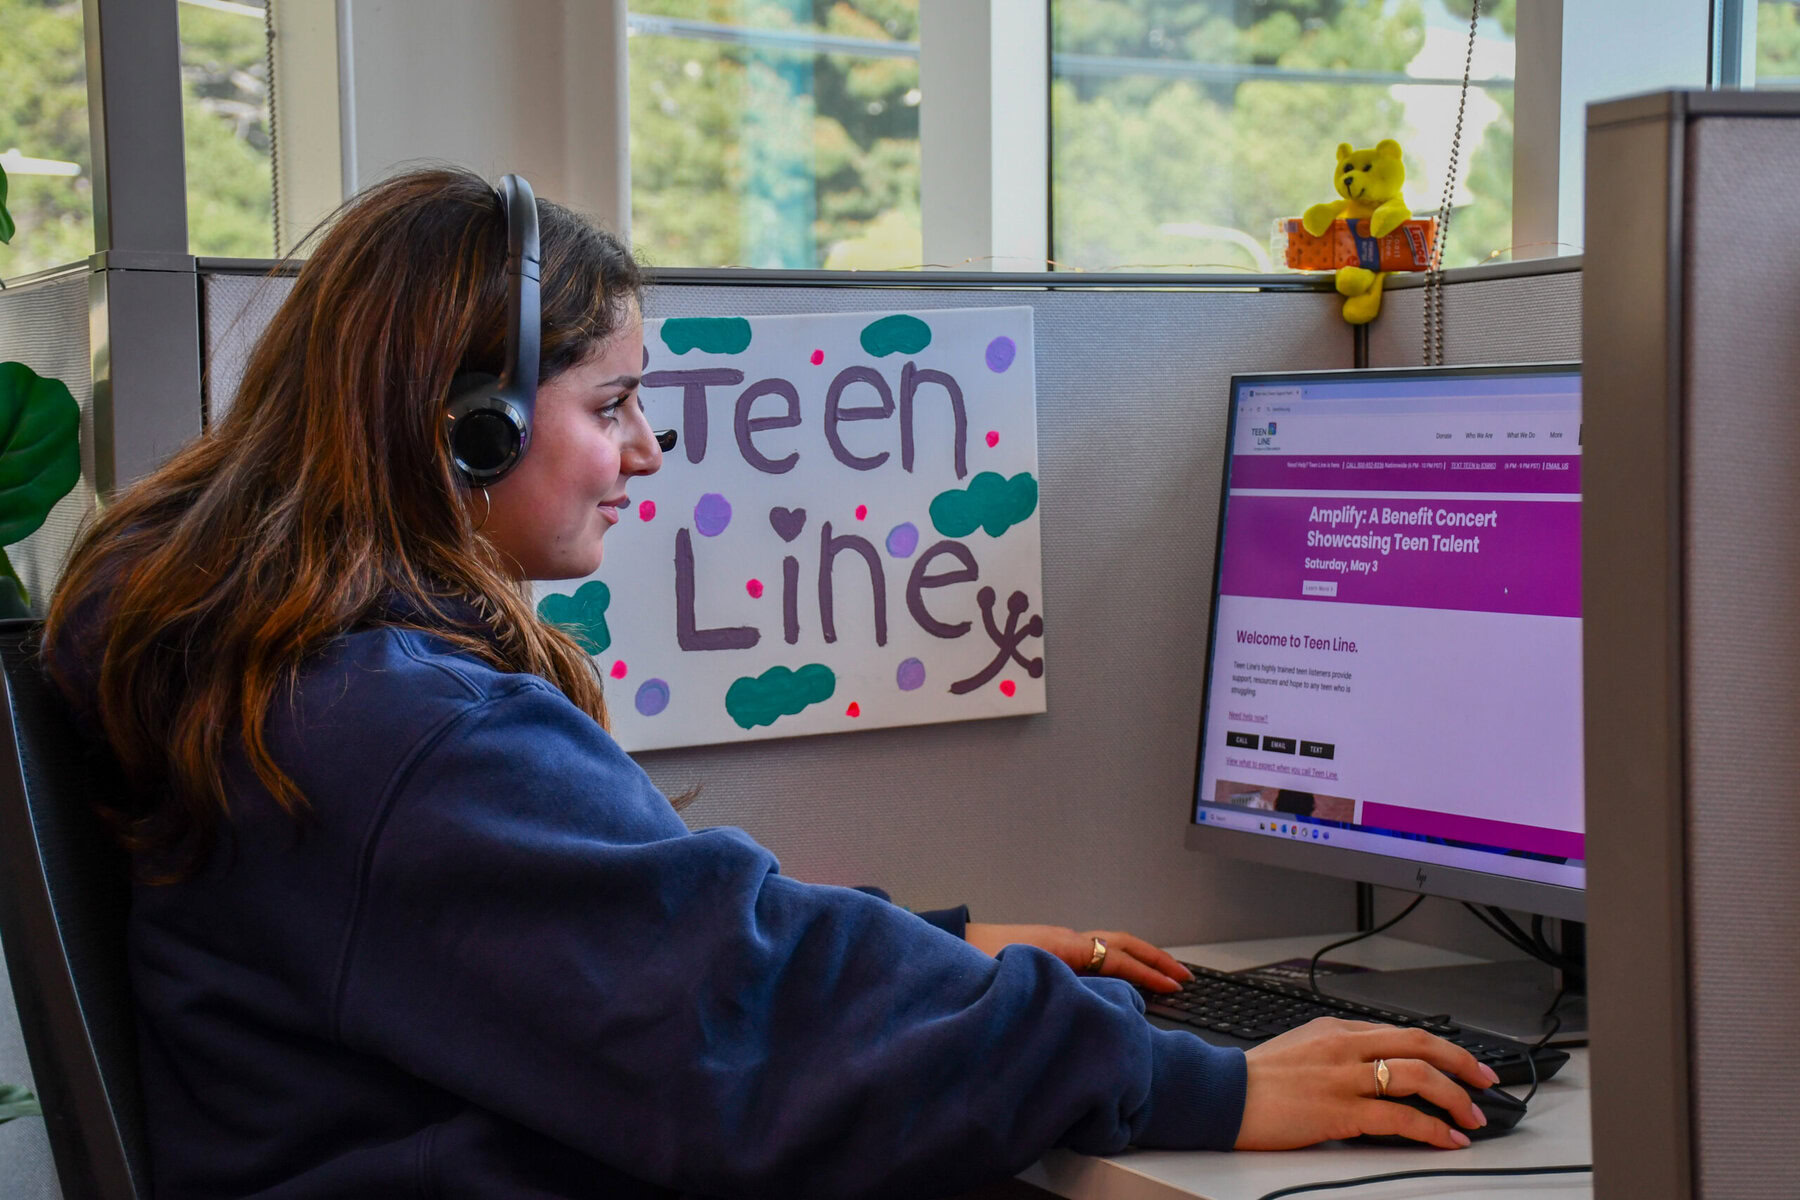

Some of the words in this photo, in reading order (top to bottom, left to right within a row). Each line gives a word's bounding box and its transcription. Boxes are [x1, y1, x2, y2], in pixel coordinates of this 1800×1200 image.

[1410, 225, 1427, 264] Lance
[641, 361, 967, 479] Teen
[1252, 428, 1267, 436] TEEN
[1436, 432, 1452, 440] Donate
[1507, 431, 1519, 439] What
[1520, 431, 1528, 439] We
[1550, 431, 1563, 439] More
[1257, 438, 1271, 446] LINE
[1346, 461, 1357, 469] CALL
[1546, 462, 1560, 470] EMAIL
[1561, 462, 1569, 470] US
[1309, 505, 1367, 529] Amplify:
[1368, 507, 1379, 524] A
[1381, 507, 1433, 526] Benefit
[1435, 509, 1498, 528] Concert
[1307, 530, 1391, 555] Showcasing
[1394, 533, 1429, 551] Teen
[1432, 535, 1480, 553] Talent
[1304, 557, 1349, 574] Saturday,
[1350, 560, 1371, 575] May
[1372, 560, 1379, 572] 3
[674, 507, 979, 650] Line
[1236, 630, 1287, 648] Welcome
[1290, 634, 1301, 648] to
[1303, 635, 1330, 651] Teen
[1333, 636, 1358, 653] Line.
[1233, 661, 1245, 669] Teen
[1246, 662, 1260, 671] Line's
[1261, 663, 1276, 673] highly
[1277, 665, 1295, 674] trained
[1296, 667, 1308, 675] teen
[1308, 668, 1331, 678] listeners
[1331, 671, 1352, 680] provide
[1253, 676, 1278, 686] resources
[1279, 679, 1288, 687] and
[1289, 680, 1302, 689] hope
[1303, 681, 1310, 689] to
[1310, 682, 1320, 691] any
[1320, 683, 1333, 691] teen
[1333, 684, 1345, 692] who
[1228, 711, 1241, 720] Need
[1236, 736, 1248, 745] CALL
[1271, 741, 1286, 750] EMAIL
[1310, 746, 1323, 754] TEXT
[1239, 758, 1251, 767] what
[1259, 761, 1276, 771] expect
[1277, 765, 1290, 773] when
[1291, 767, 1300, 776] you
[1301, 767, 1311, 776] call
[1312, 768, 1325, 778] Teen
[1416, 868, 1427, 888] hp
